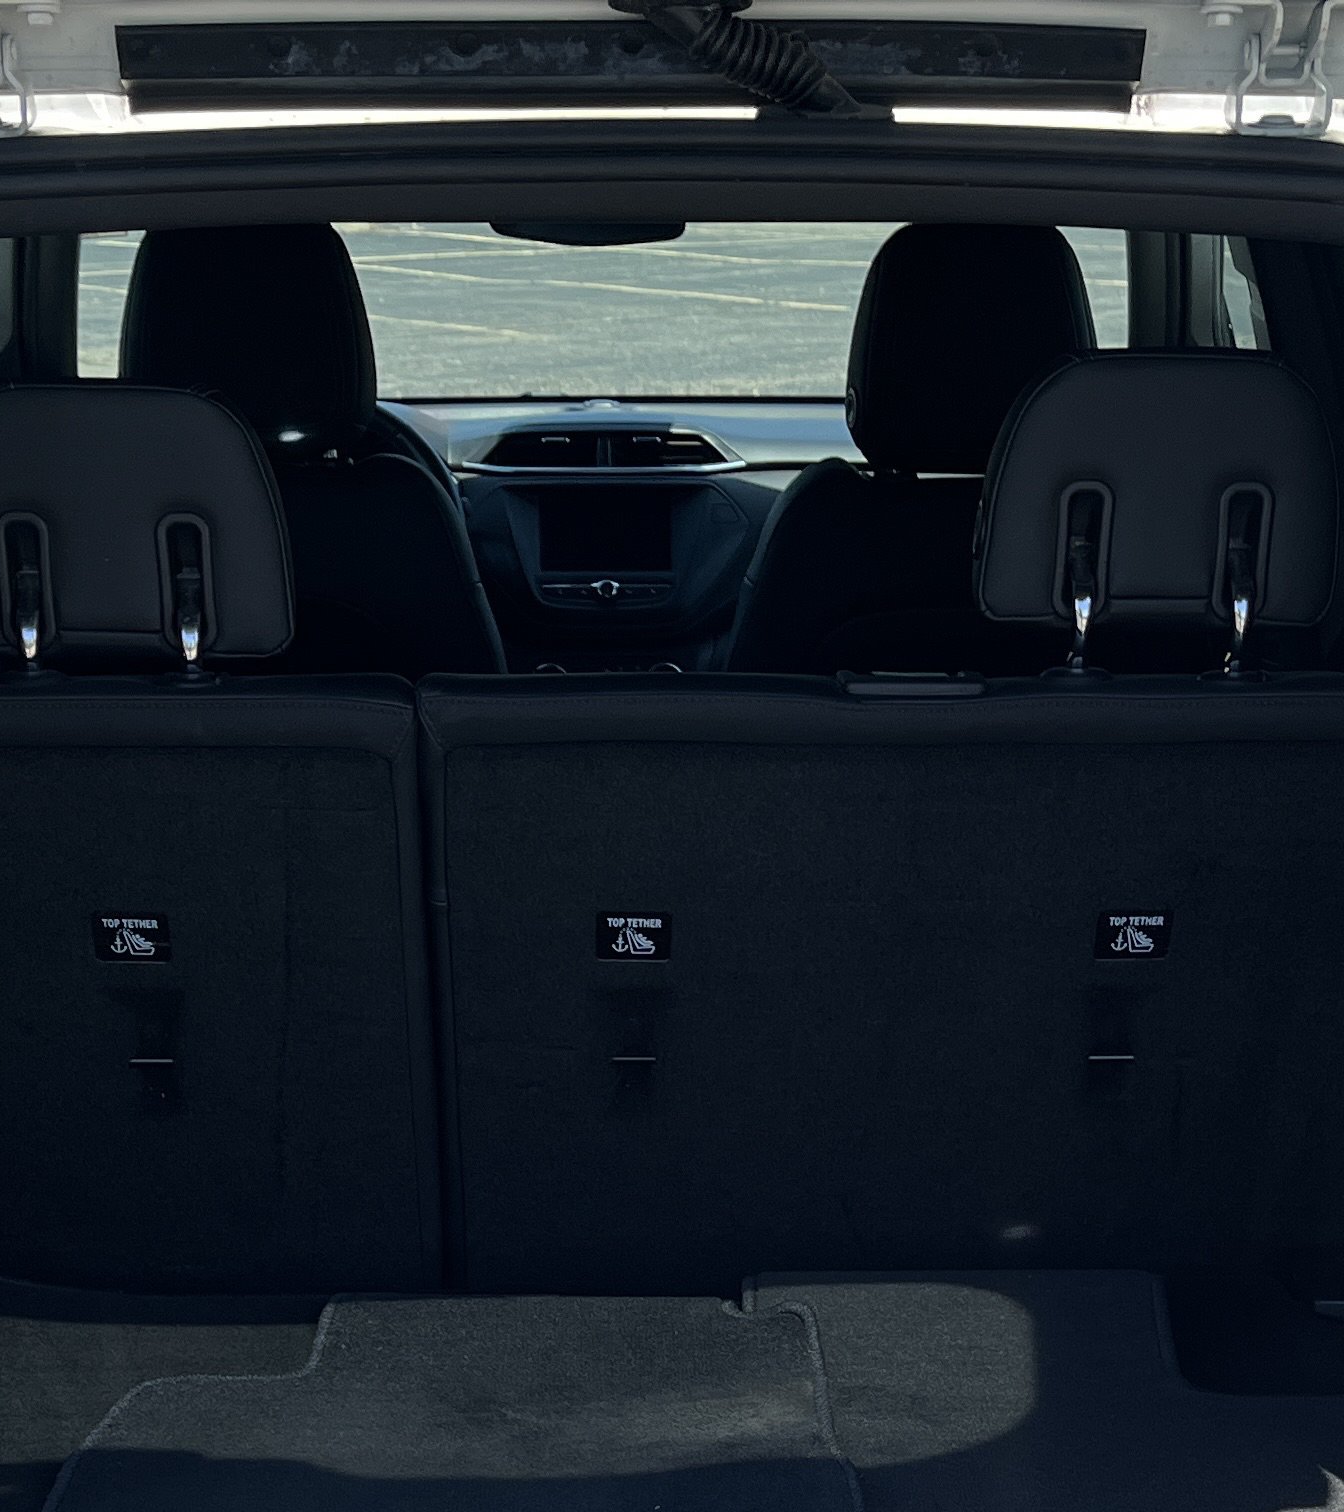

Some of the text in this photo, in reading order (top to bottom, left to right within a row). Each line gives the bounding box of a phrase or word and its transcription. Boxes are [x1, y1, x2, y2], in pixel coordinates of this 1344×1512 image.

[101, 918, 158, 929] TOP TETHER
[607, 917, 662, 929] TOP TETHER
[1109, 915, 1164, 926] TOP TETHER
